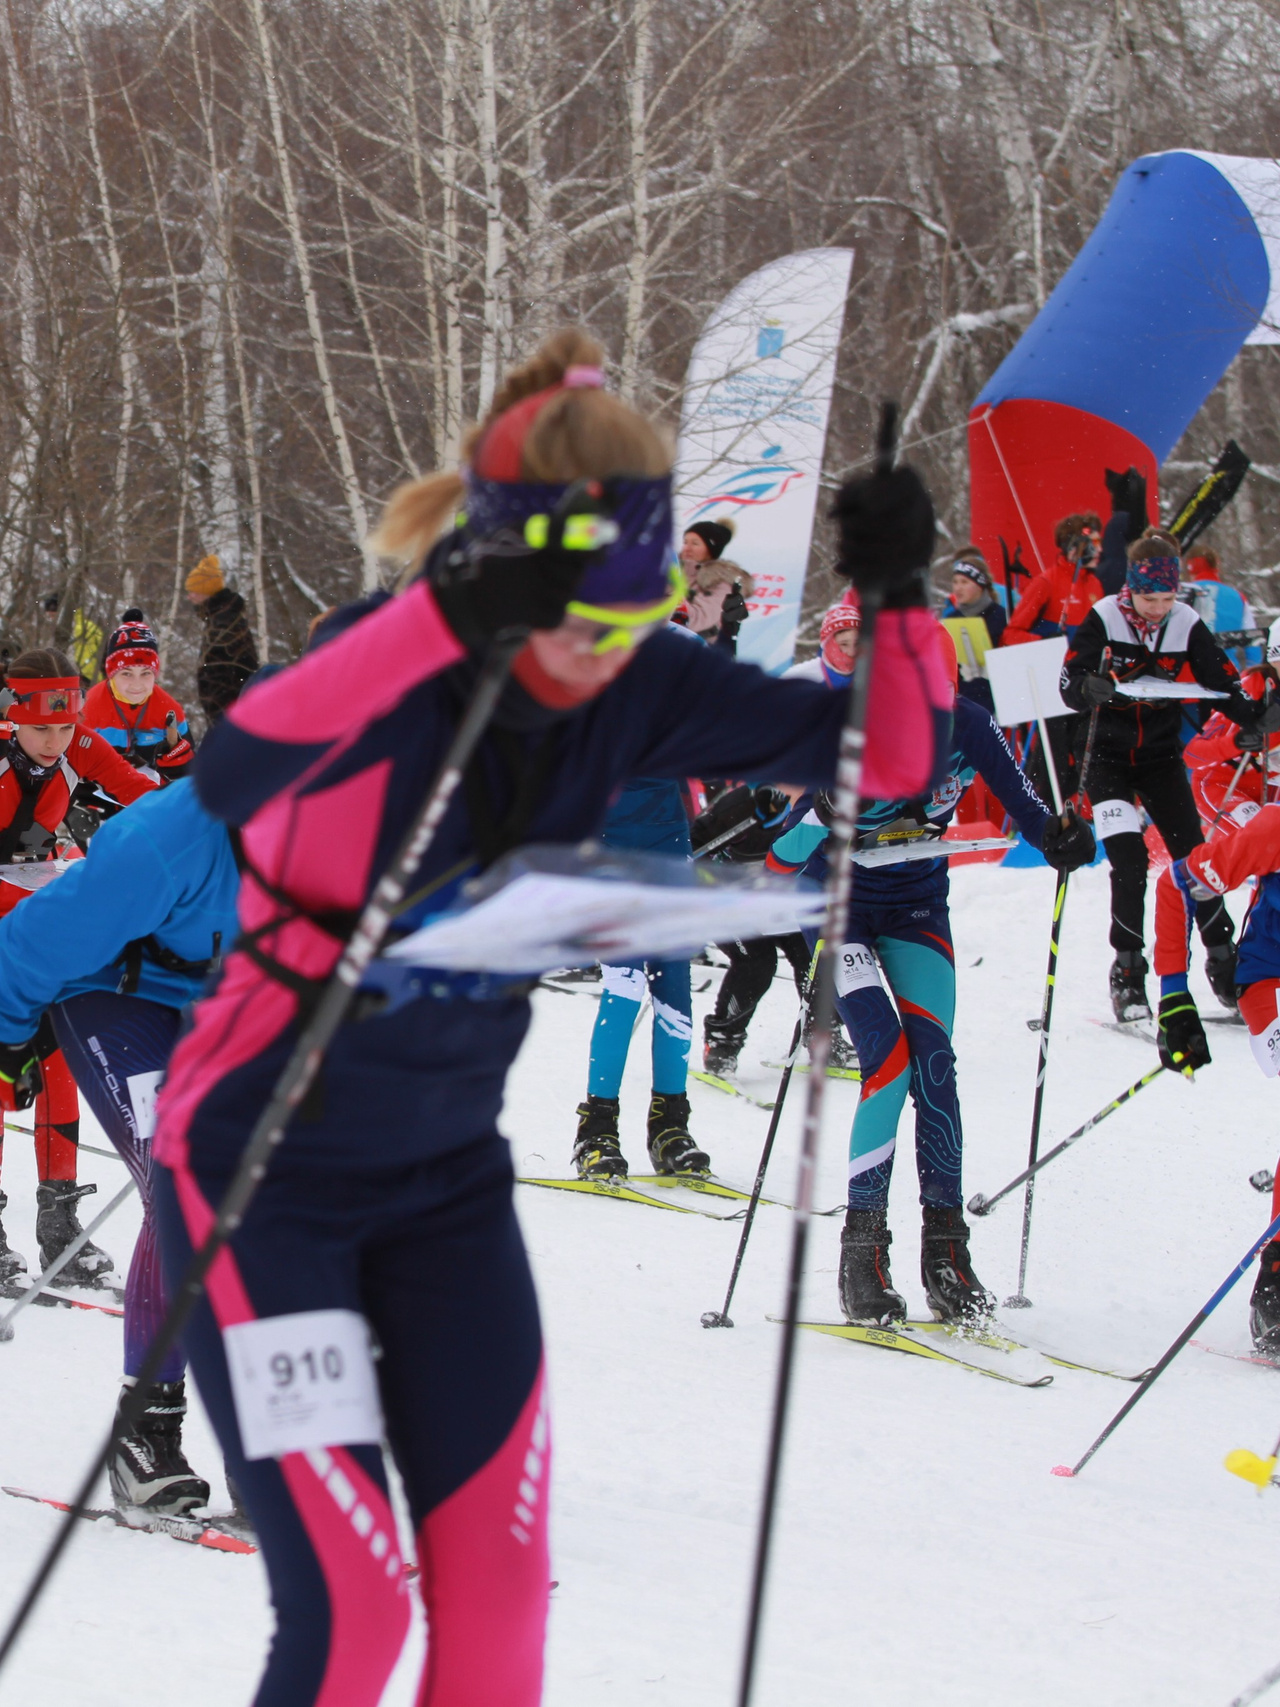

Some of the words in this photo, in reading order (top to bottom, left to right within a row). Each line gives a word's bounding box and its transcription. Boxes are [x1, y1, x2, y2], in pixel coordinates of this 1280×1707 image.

[1101, 807, 1123, 820] 942
[843, 951, 873, 968] 915
[864, 1329, 898, 1346] FISCHER
[267, 1344, 345, 1390] 910
